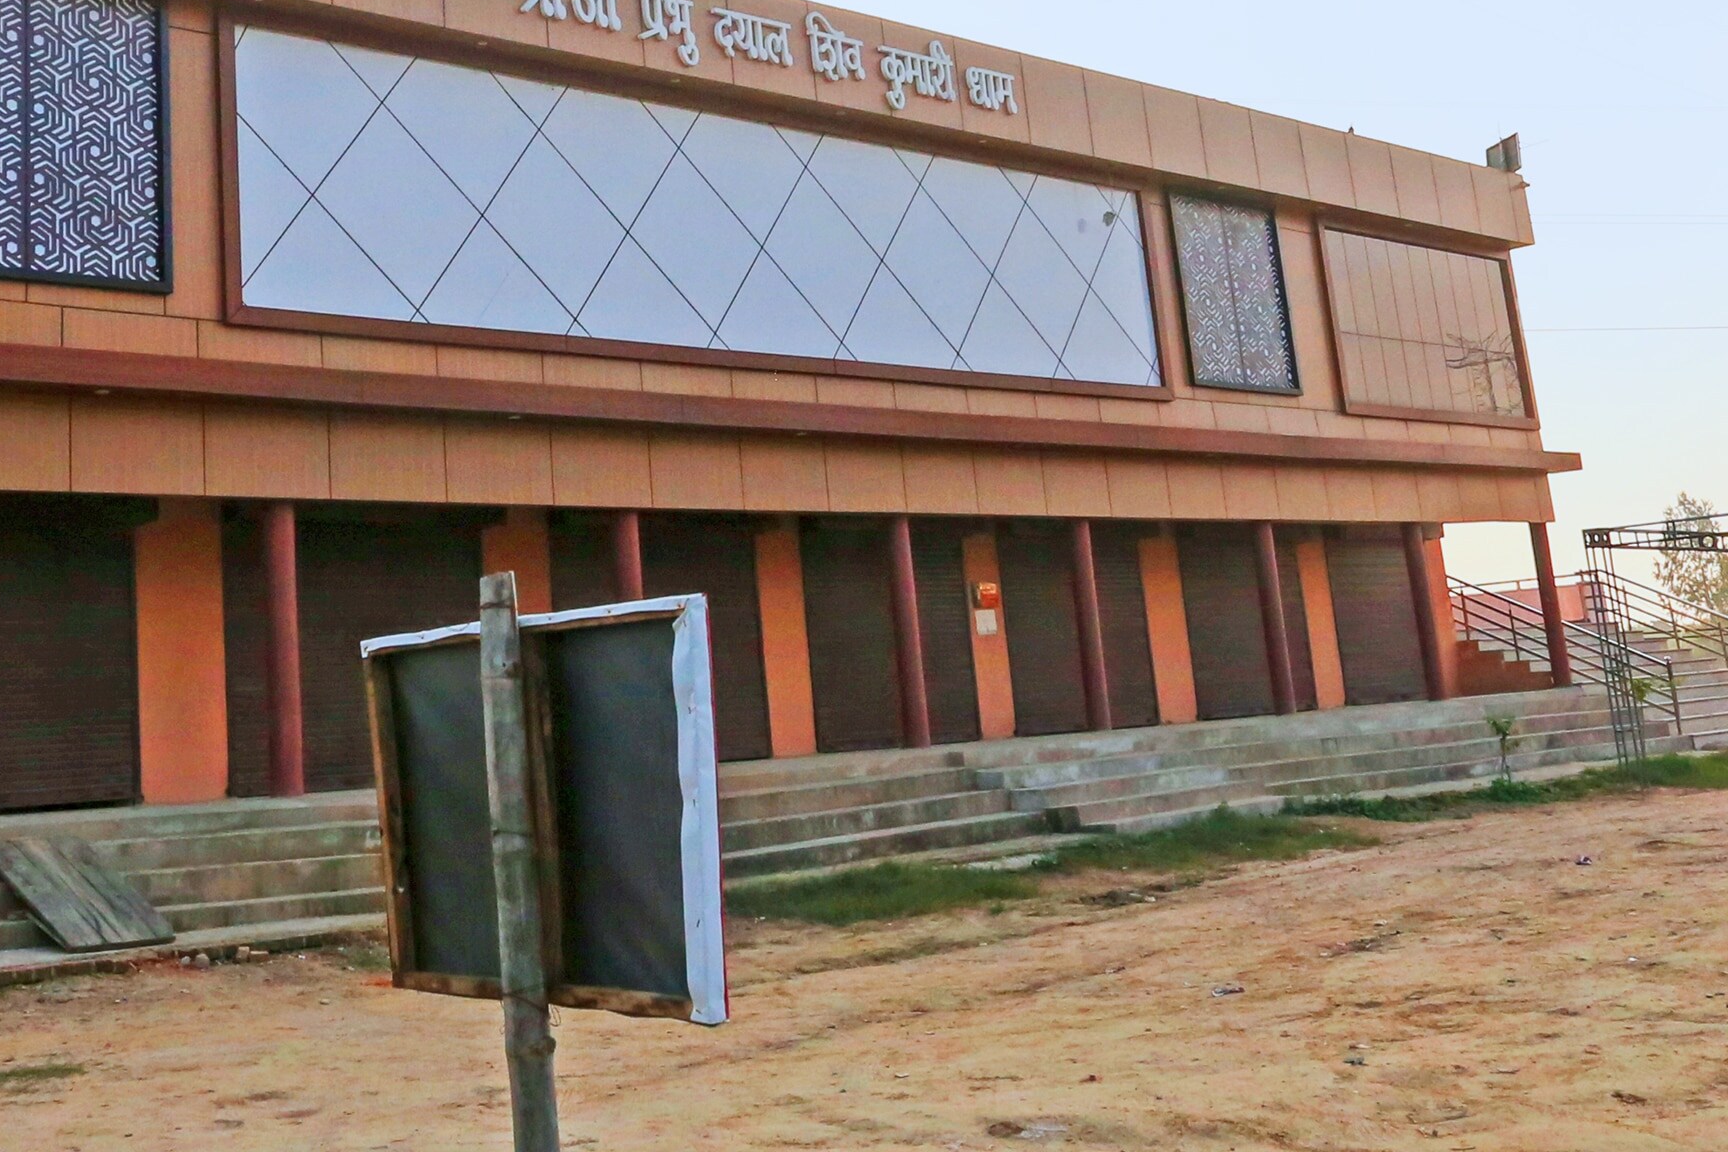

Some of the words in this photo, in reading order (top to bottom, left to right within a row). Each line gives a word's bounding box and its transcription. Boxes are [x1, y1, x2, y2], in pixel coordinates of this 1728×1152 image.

[710, 6, 794, 67] दयाल
[806, 10, 865, 81] शिव
[877, 39, 956, 111] कुमारी
[965, 65, 1019, 115] धाम
